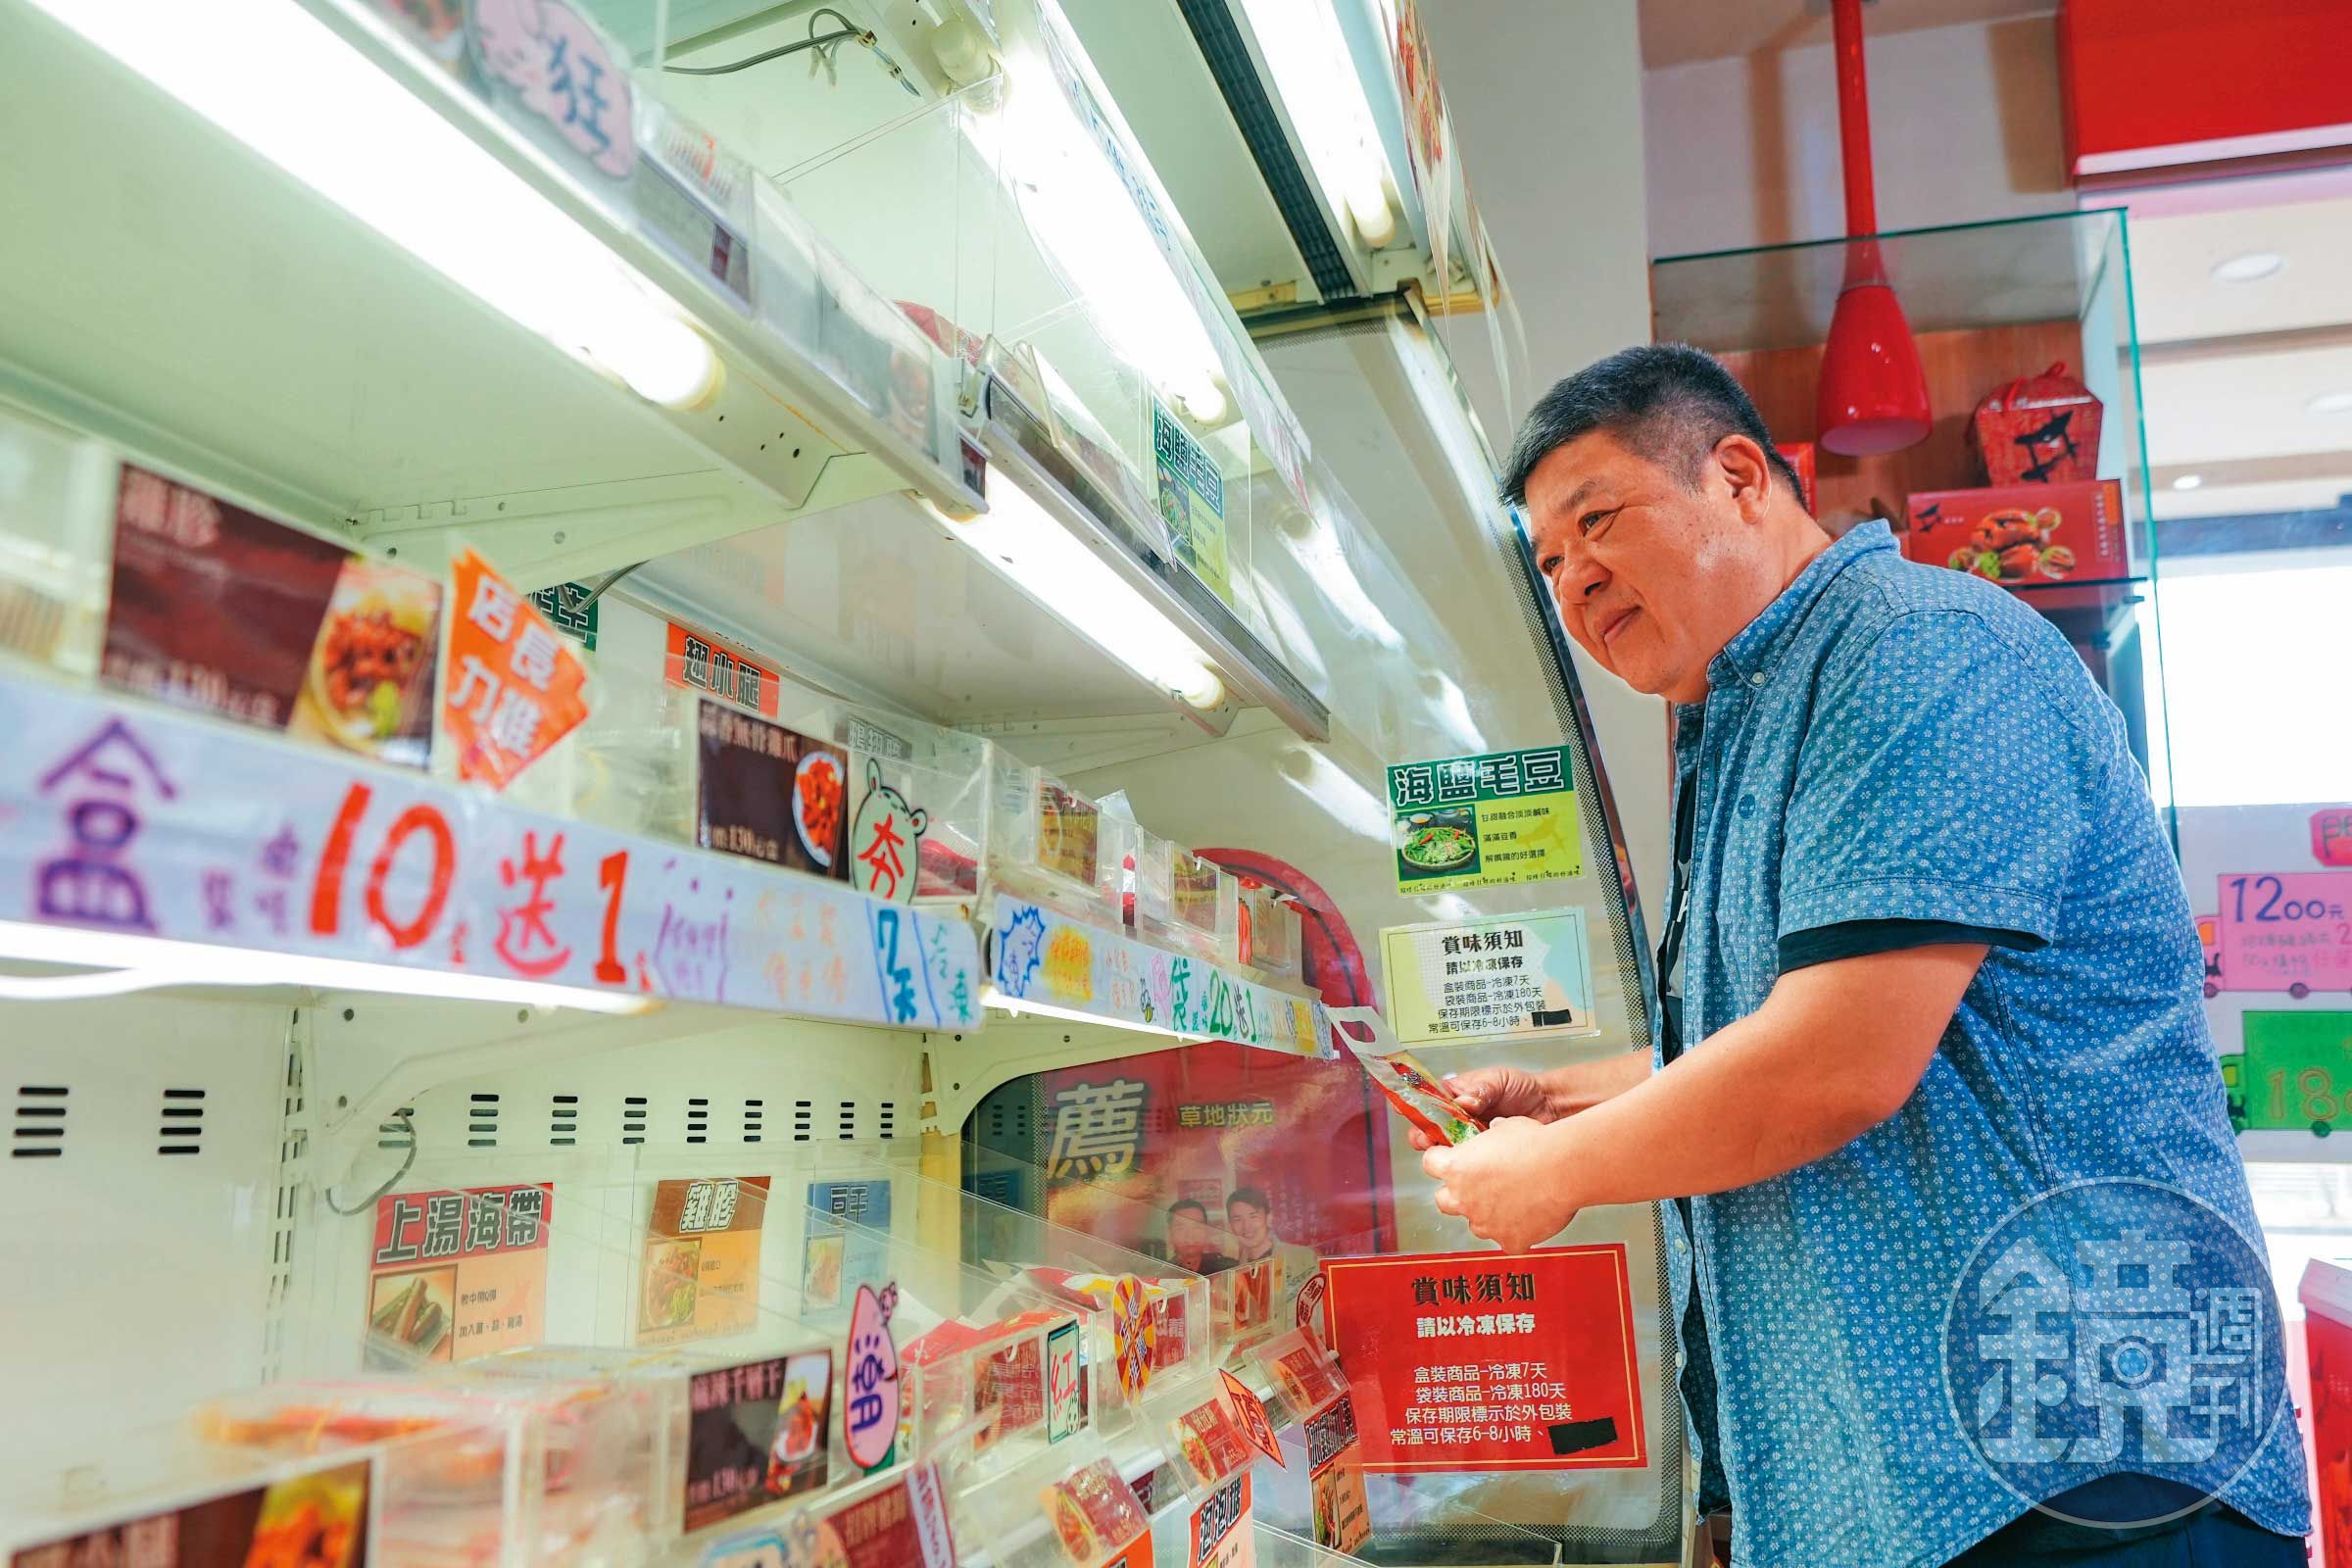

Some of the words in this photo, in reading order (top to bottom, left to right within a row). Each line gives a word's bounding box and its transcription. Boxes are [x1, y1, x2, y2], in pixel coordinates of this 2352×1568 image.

[1394, 750, 1565, 808] 海鹽毛豆
[1442, 930, 1524, 956] 賞味須知
[1446, 956, 1524, 975] 請以冷凍保存
[1438, 1001, 1547, 1020] 保存期限標示於外包裝
[1178, 1102, 1274, 1128] 草地狀元
[375, 1189, 544, 1265] 上湯海帶
[1411, 1271, 1537, 1306] 賞味須知
[1416, 1313, 1536, 1339] 請以冷凍保存
[1413, 1361, 1547, 1384] 盒裝商品-冷凍7天
[1415, 1382, 1567, 1404] 袋裝商品-冷凍180天
[1404, 1402, 1573, 1425] 保存期限標示於外包裝
